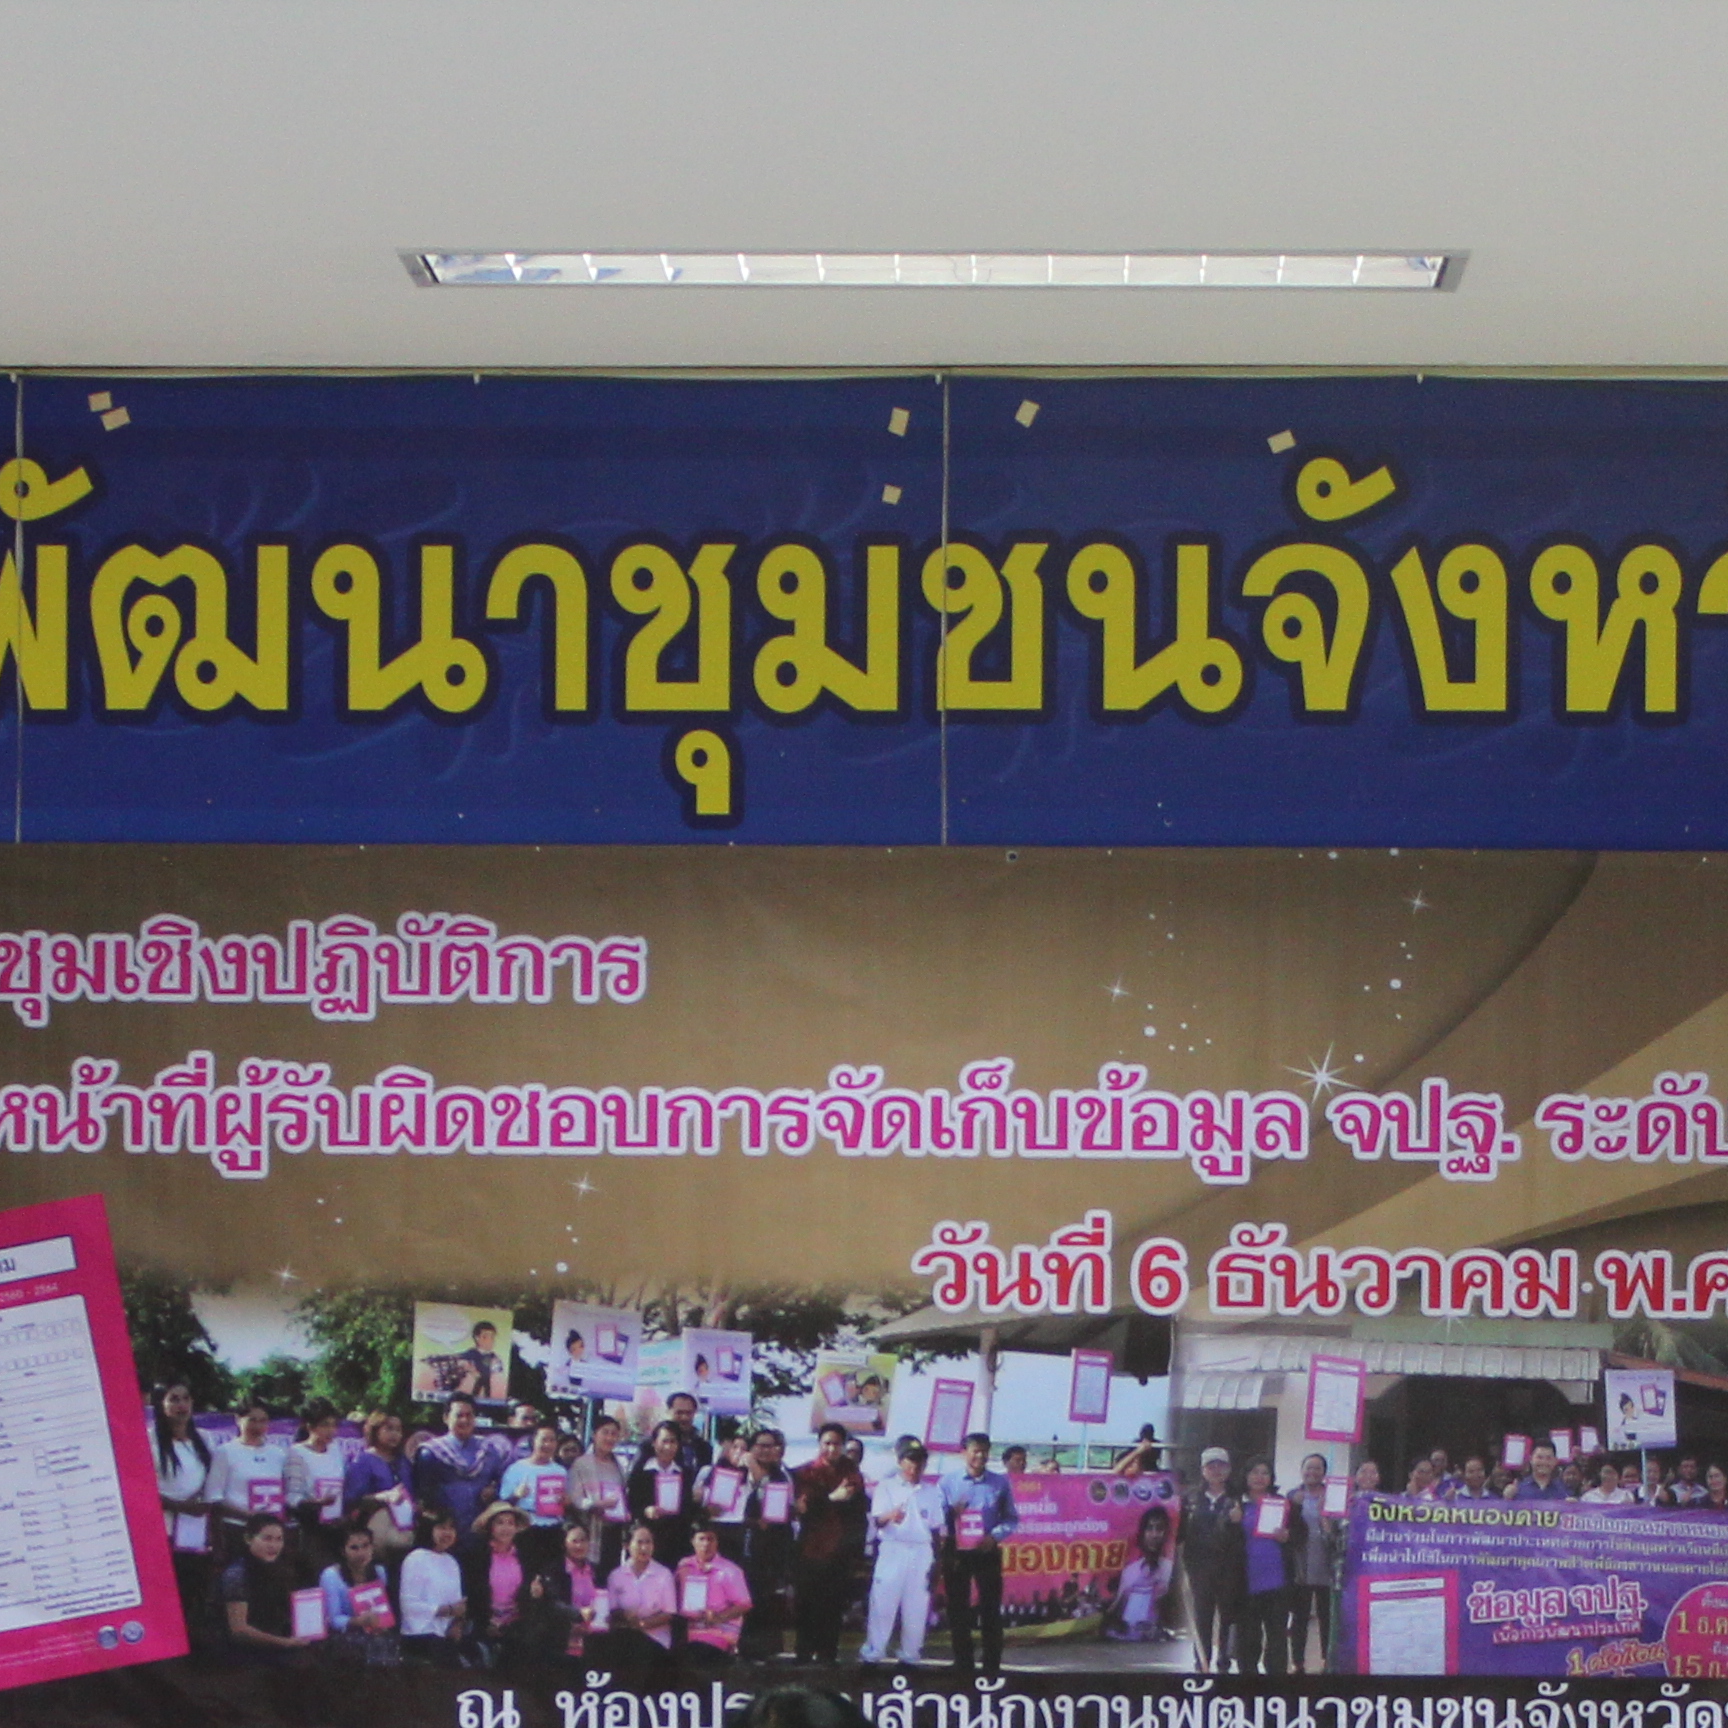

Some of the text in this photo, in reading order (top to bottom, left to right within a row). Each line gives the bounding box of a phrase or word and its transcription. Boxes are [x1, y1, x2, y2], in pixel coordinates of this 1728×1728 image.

[1329, 1078, 1521, 1173] จปฐ.
[914, 1210, 1114, 1318] วันที่
[1130, 1238, 1188, 1316] 6
[1208, 1222, 1578, 1318] ธันวาคม
[1467, 1581, 1567, 1628] ข้อมูล
[1676, 1610, 1690, 1634] 1
